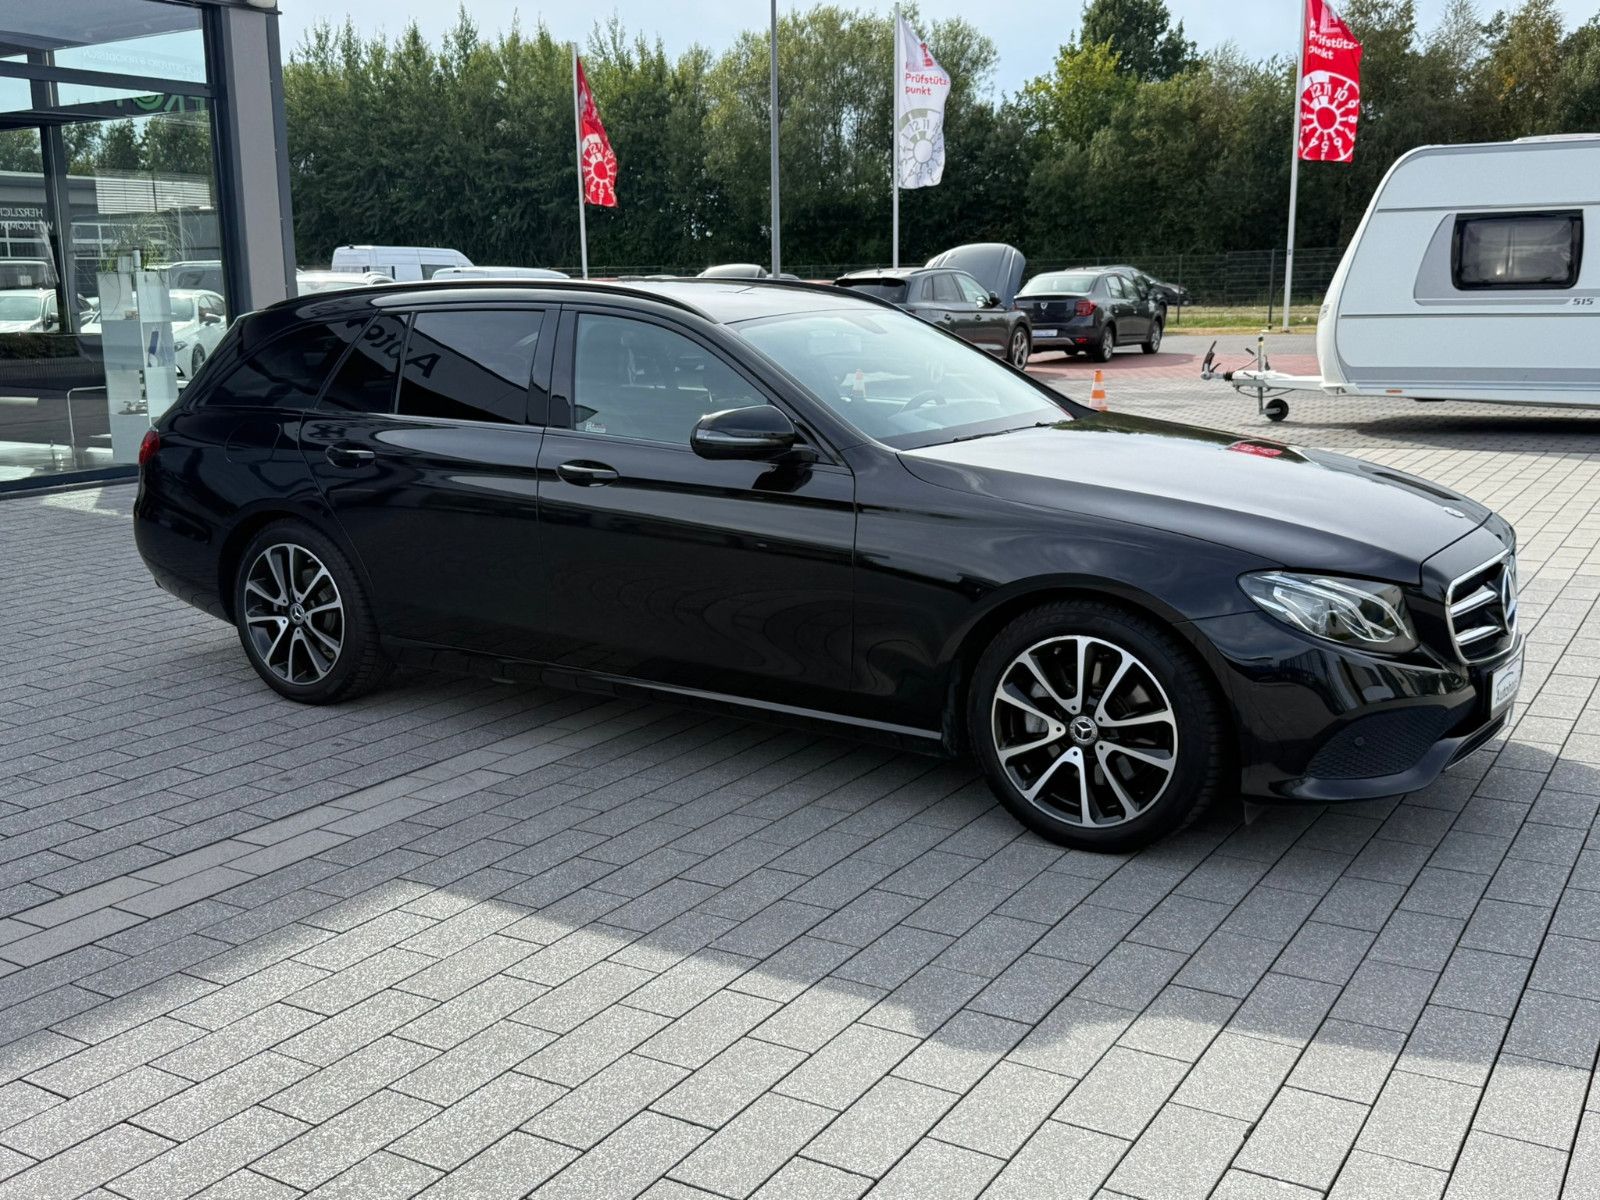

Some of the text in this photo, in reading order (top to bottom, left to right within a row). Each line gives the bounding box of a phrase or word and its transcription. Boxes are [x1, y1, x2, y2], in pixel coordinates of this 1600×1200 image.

[905, 86, 932, 95] punkt
[1309, 83, 1322, 98] 12
[1323, 83, 1332, 96] 11
[1334, 87, 1348, 101] 10
